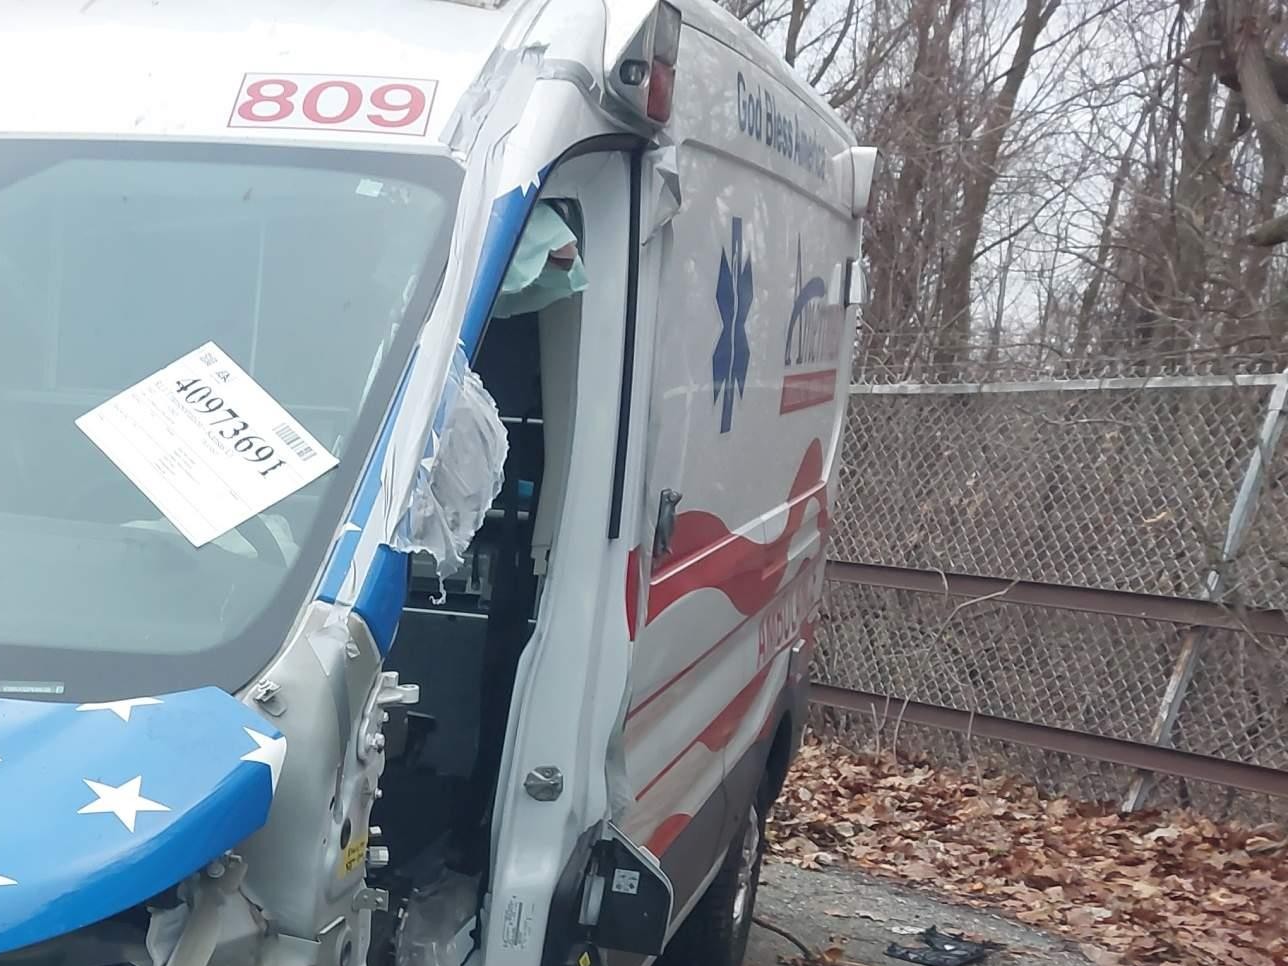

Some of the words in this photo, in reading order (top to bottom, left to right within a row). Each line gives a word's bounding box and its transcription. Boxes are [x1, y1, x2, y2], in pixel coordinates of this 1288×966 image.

[237, 78, 426, 128] 809
[737, 71, 762, 141] God
[764, 88, 793, 160] Bless
[175, 378, 287, 480] 40973691
